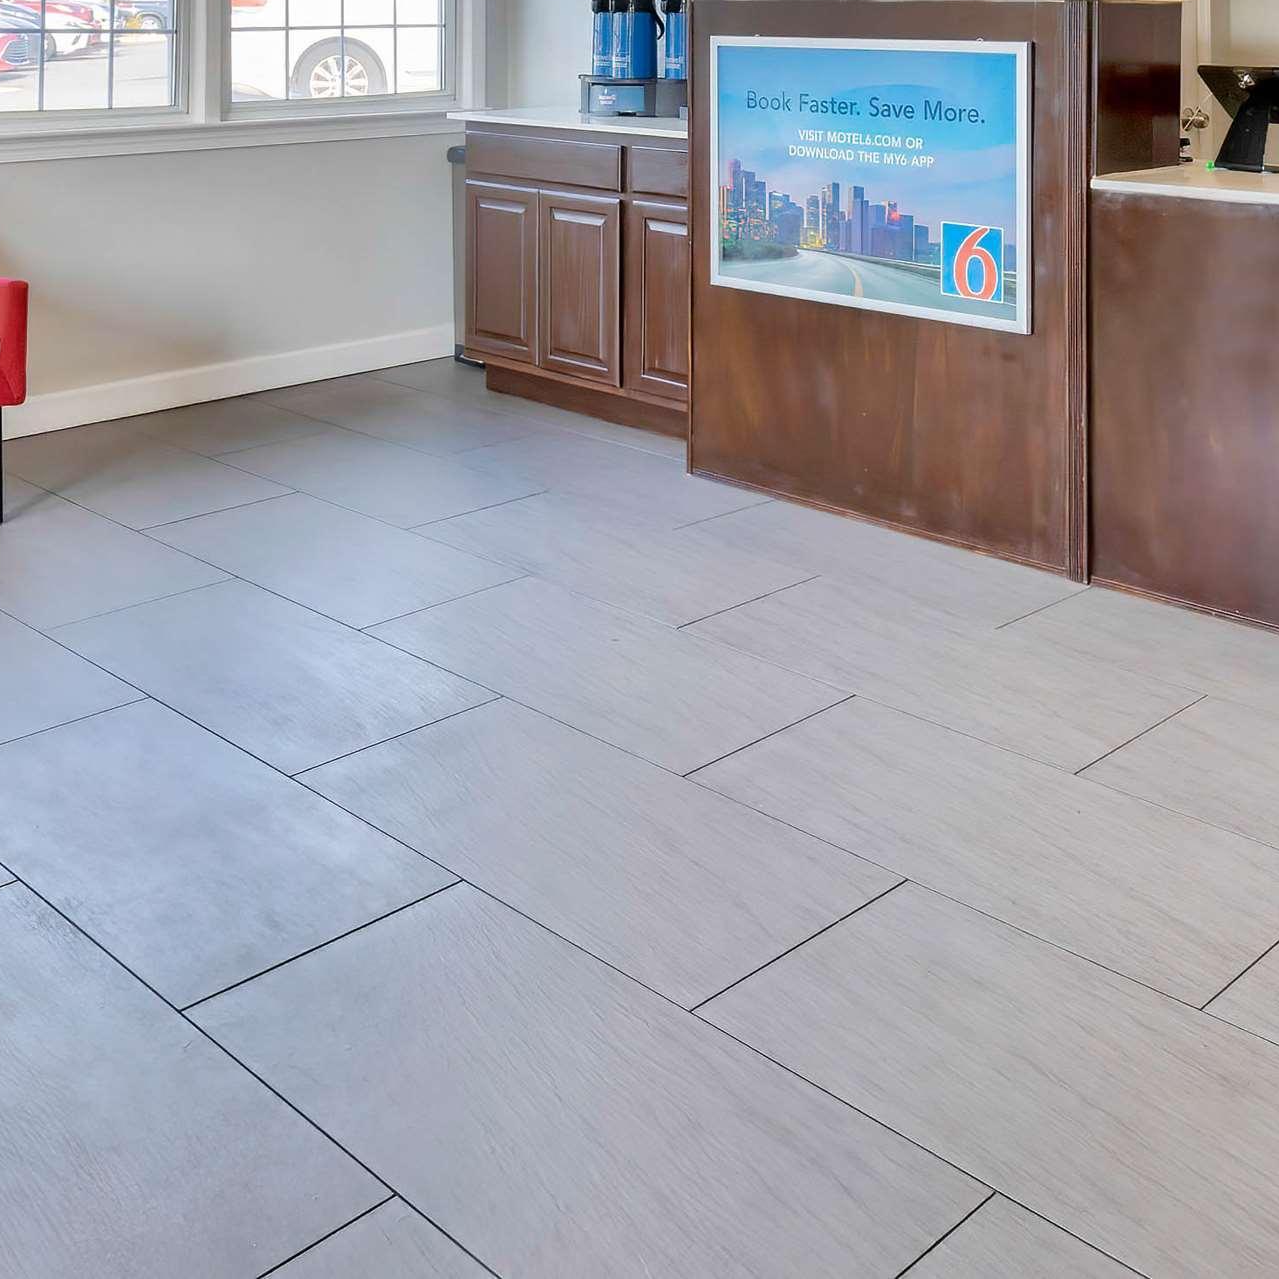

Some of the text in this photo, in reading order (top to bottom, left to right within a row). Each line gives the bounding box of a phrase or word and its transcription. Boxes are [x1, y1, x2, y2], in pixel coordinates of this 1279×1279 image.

[747, 90, 985, 124] Book Faster. Save More.
[799, 129, 924, 149] VISIT MOTEL6.COM OR
[788, 145, 935, 168] DOWNLOAD THE MY6 APP
[953, 226, 999, 301] 6
